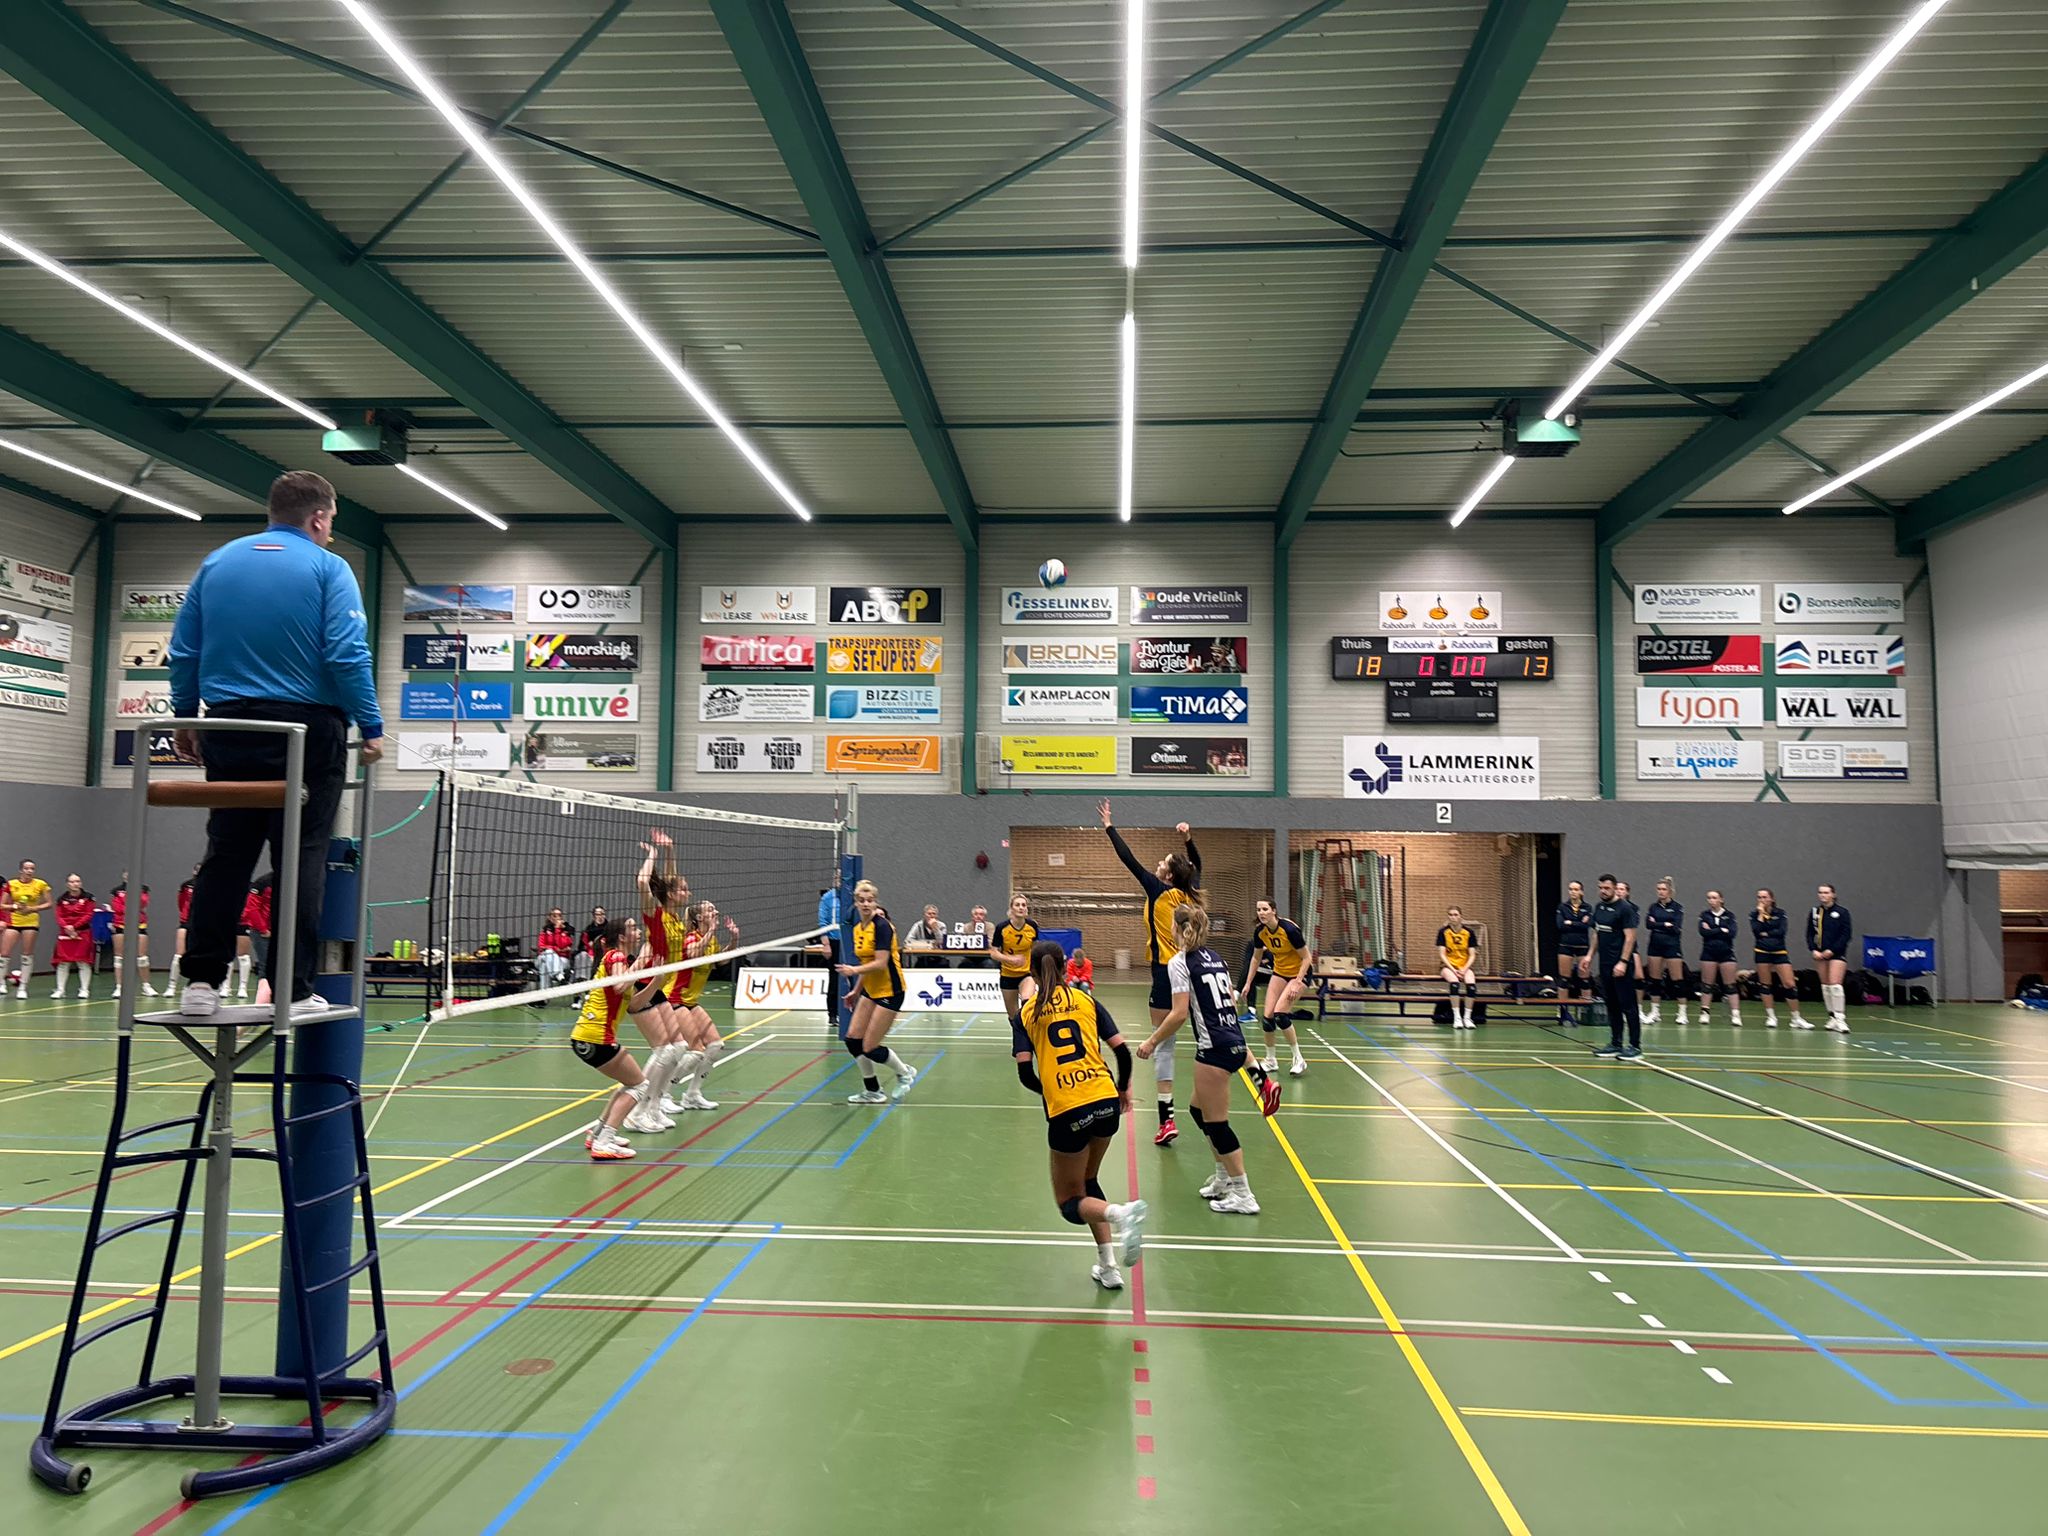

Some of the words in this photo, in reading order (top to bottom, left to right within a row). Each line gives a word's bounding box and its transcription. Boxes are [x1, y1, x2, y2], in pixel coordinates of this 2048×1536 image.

[588, 589, 632, 599] OPHUIS
[1008, 592, 1088, 609] HESSELINK
[1157, 591, 1190, 603] Oude
[1193, 591, 1242, 603] Vrielink
[588, 600, 632, 609] OPTIEK
[1807, 597, 1901, 609] BonsenReuling
[723, 612, 752, 622] LEASE
[779, 612, 808, 622] LEASE
[829, 638, 921, 649] TRAPSUPPORTERS
[1137, 640, 1191, 658] Avontuur
[1341, 638, 1372, 649] thuis
[1393, 640, 1435, 649] Rabobank
[1451, 640, 1493, 649] Rabobank
[1505, 639, 1548, 653] gasten
[1640, 640, 1712, 655] POSTEL
[469, 646, 498, 655] VWZ
[715, 638, 803, 663] artica
[1030, 645, 1117, 660] BRONS
[1818, 650, 1878, 664] PLEGT
[1140, 659, 1158, 669] aan
[1357, 656, 1382, 676] 18
[1521, 656, 1548, 676] 13
[1712, 664, 1760, 672] POSTEL.NL
[866, 690, 934, 701] BIZZSITE
[1030, 690, 1110, 700] KAMPLACON
[1660, 690, 1739, 724] fyon
[1781, 698, 1838, 717] WAL
[1845, 698, 1903, 718] WAL
[1676, 747, 1738, 755] EURONICS
[1410, 755, 1535, 769] LAMMERINK
[1676, 757, 1739, 778] LASHOF
[1410, 774, 1535, 784] INSTALLATIEGROEP
[1439, 806, 1450, 821] 2
[1015, 934, 1024, 945] 7
[1270, 937, 1282, 949] 10
[776, 979, 814, 995] WH
[1200, 971, 1235, 1010] 19
[1047, 1019, 1087, 1066] 9
[1056, 1068, 1099, 1089] fyon
